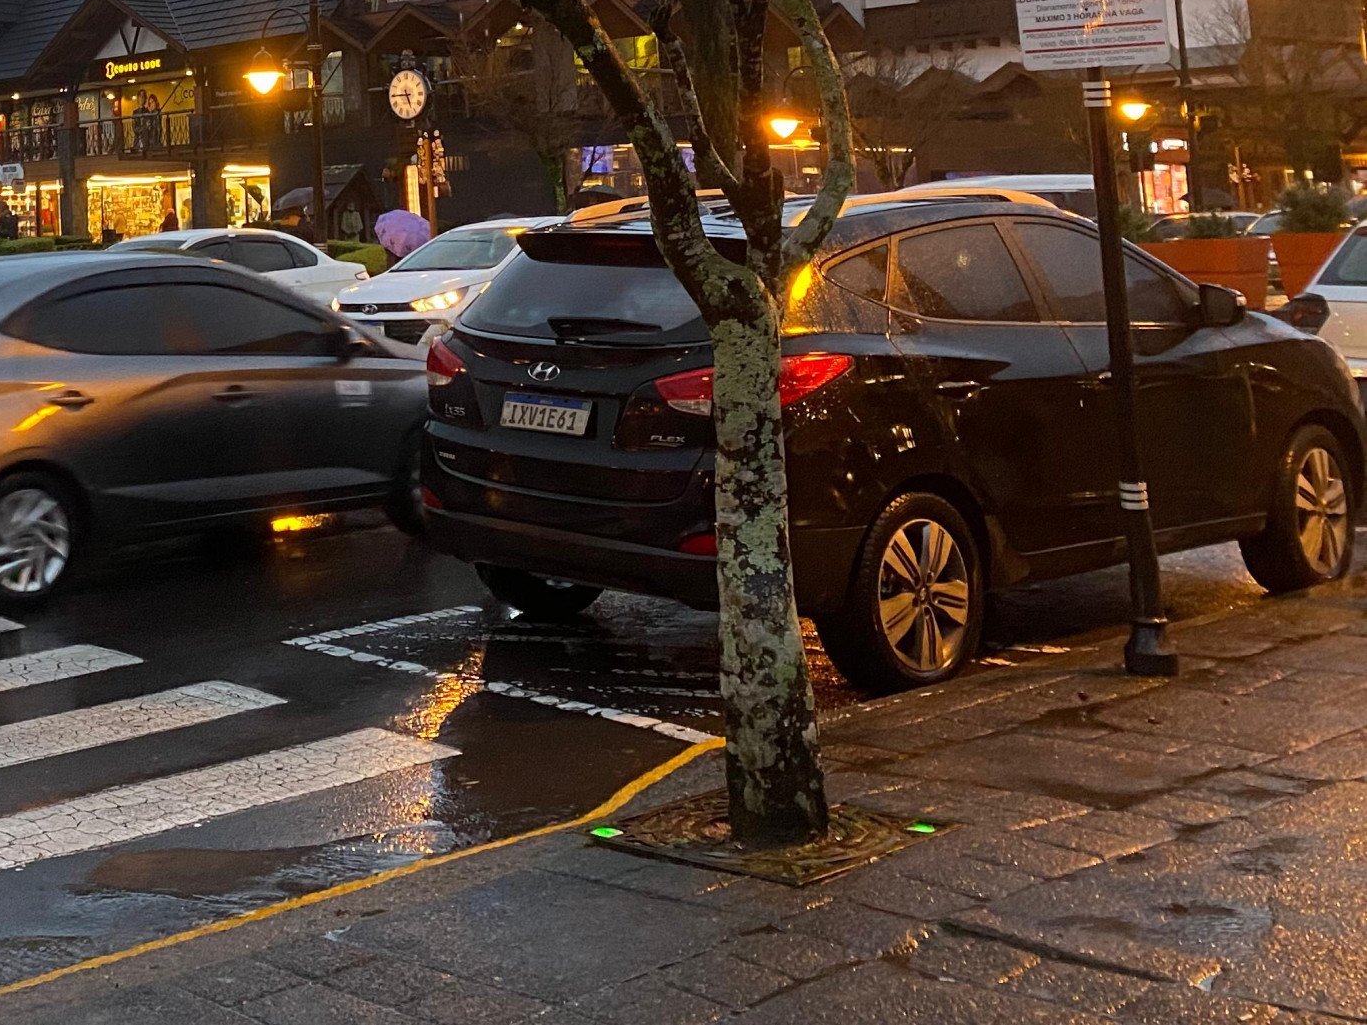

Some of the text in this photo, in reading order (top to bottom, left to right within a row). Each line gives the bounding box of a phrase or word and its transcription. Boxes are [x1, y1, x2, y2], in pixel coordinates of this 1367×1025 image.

[1119, 7, 1145, 16] VAGA
[508, 404, 578, 431] IXV1E61
[650, 435, 685, 443] FLEX
